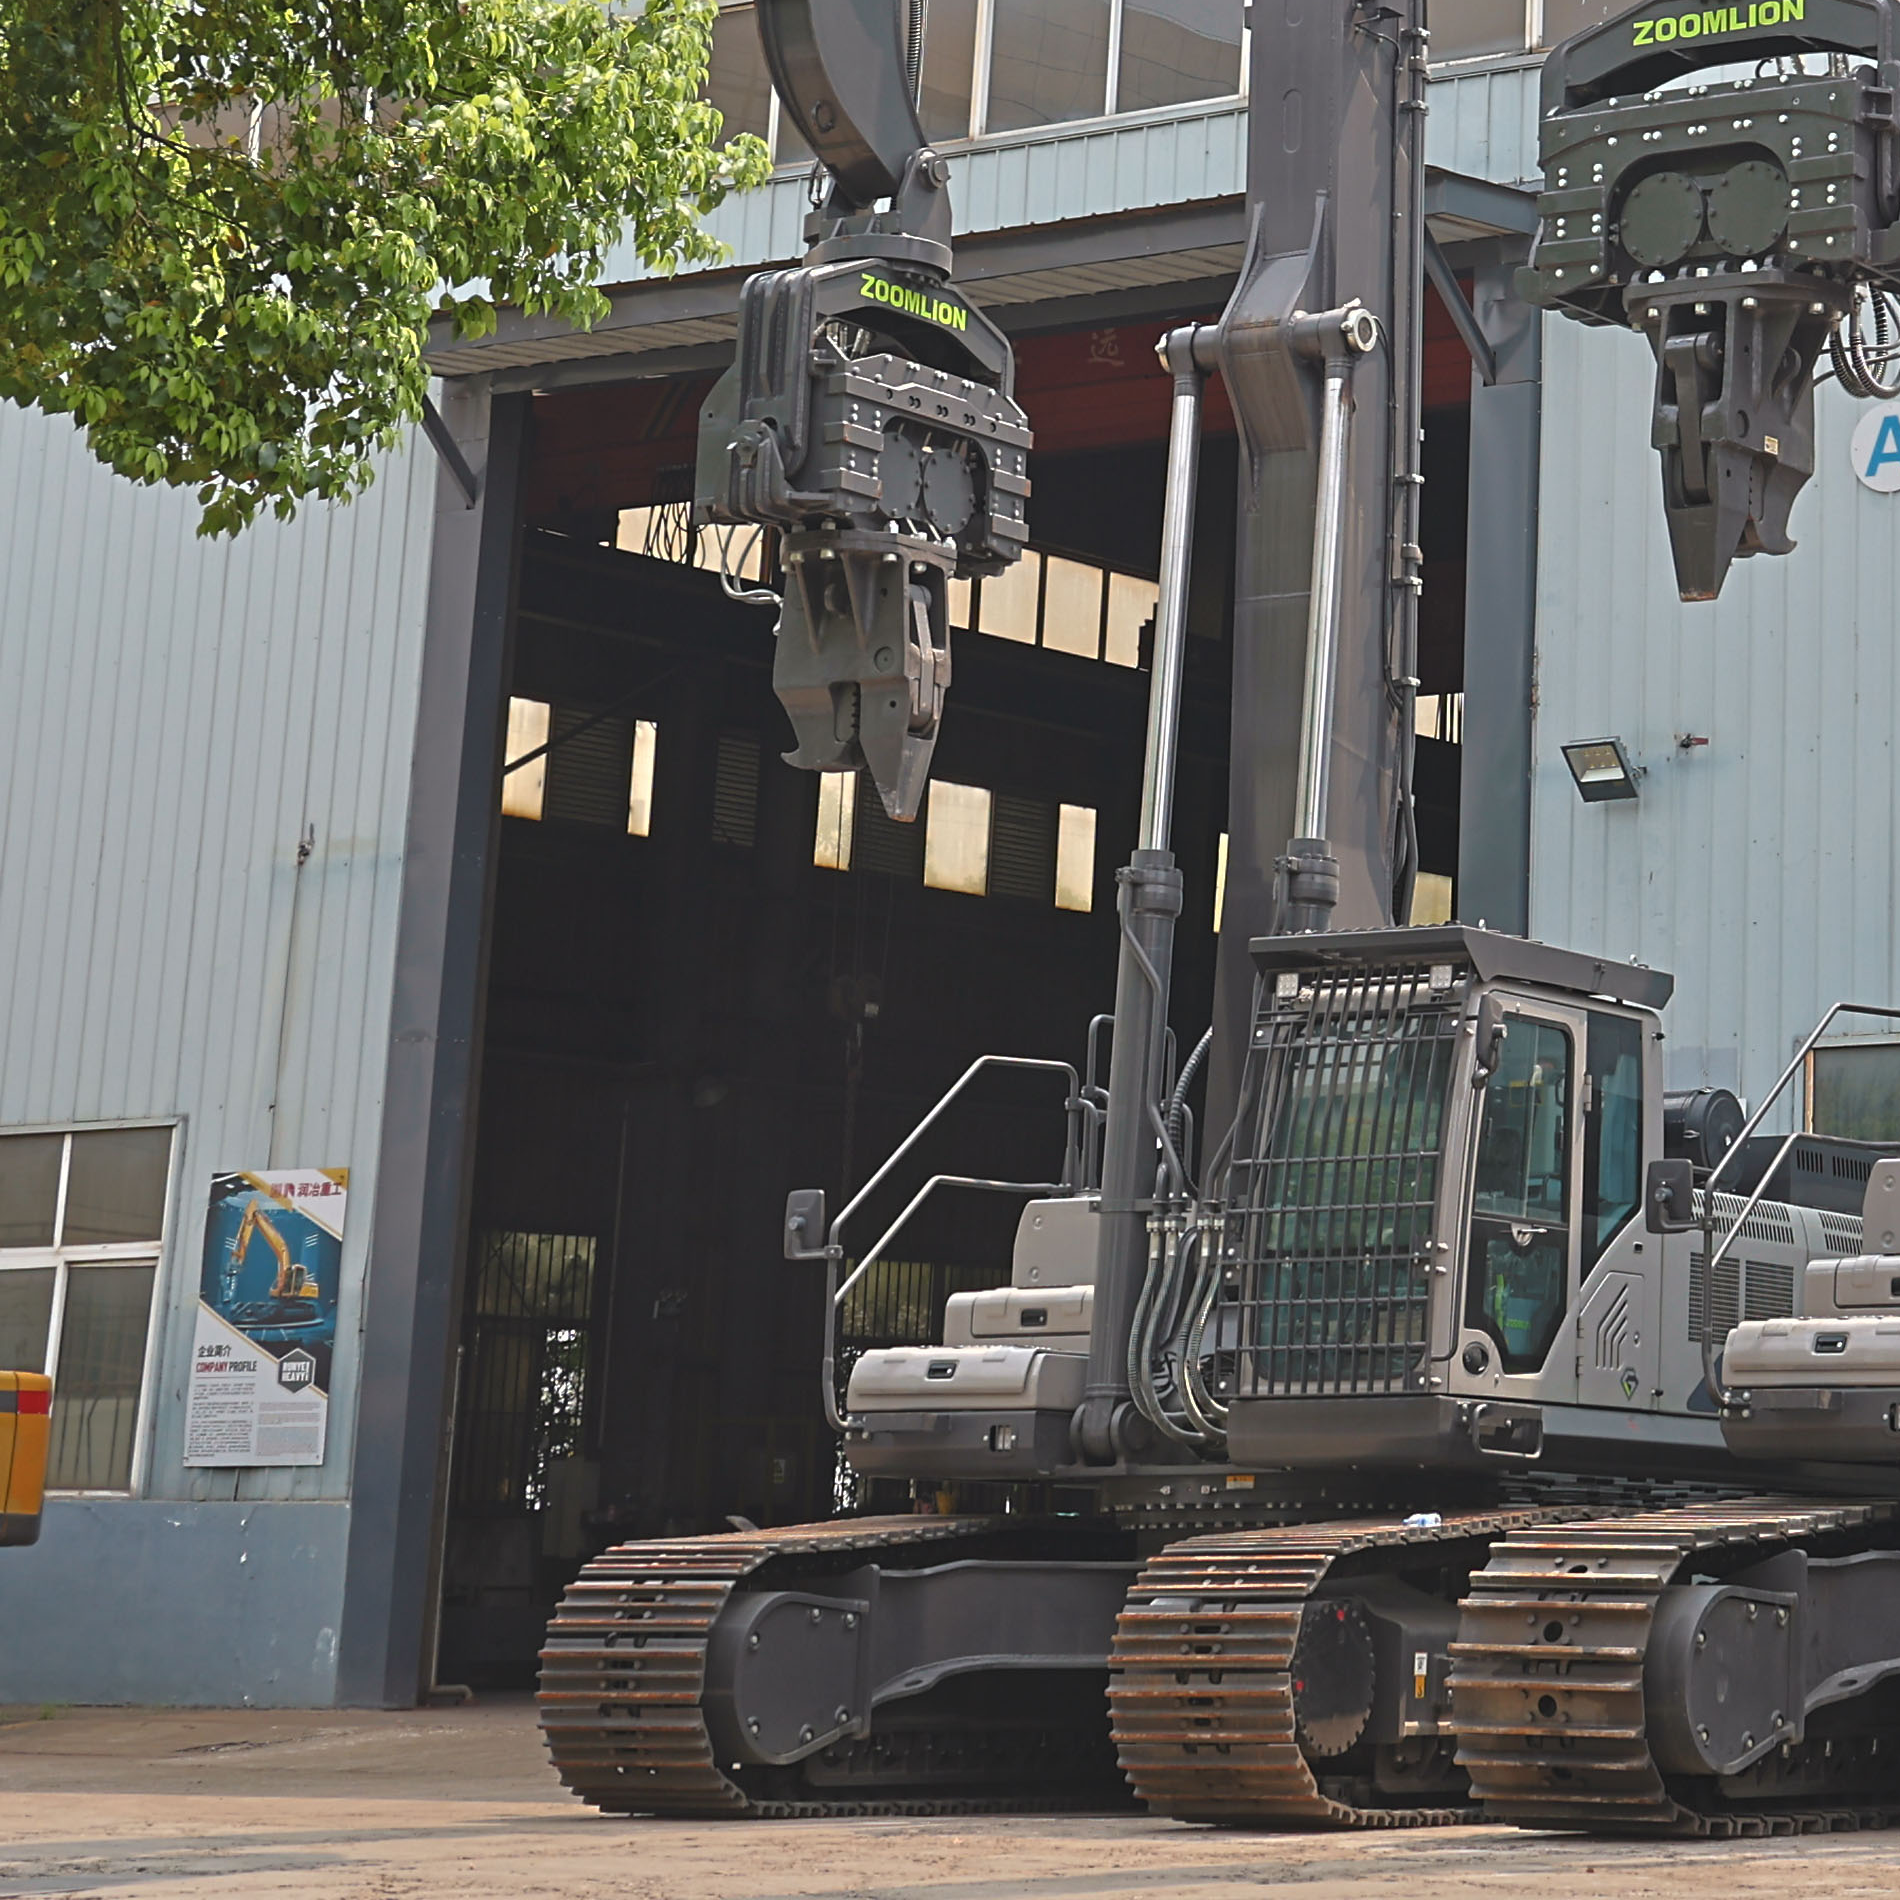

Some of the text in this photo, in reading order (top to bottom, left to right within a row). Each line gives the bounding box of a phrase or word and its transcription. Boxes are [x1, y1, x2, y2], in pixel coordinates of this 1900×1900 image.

[860, 273, 967, 331] ZOOMLION
[297, 1182, 342, 1197] 润冶重工
[197, 1344, 232, 1358] 企业简介
[196, 1360, 257, 1373] COMPANY PROFILE
